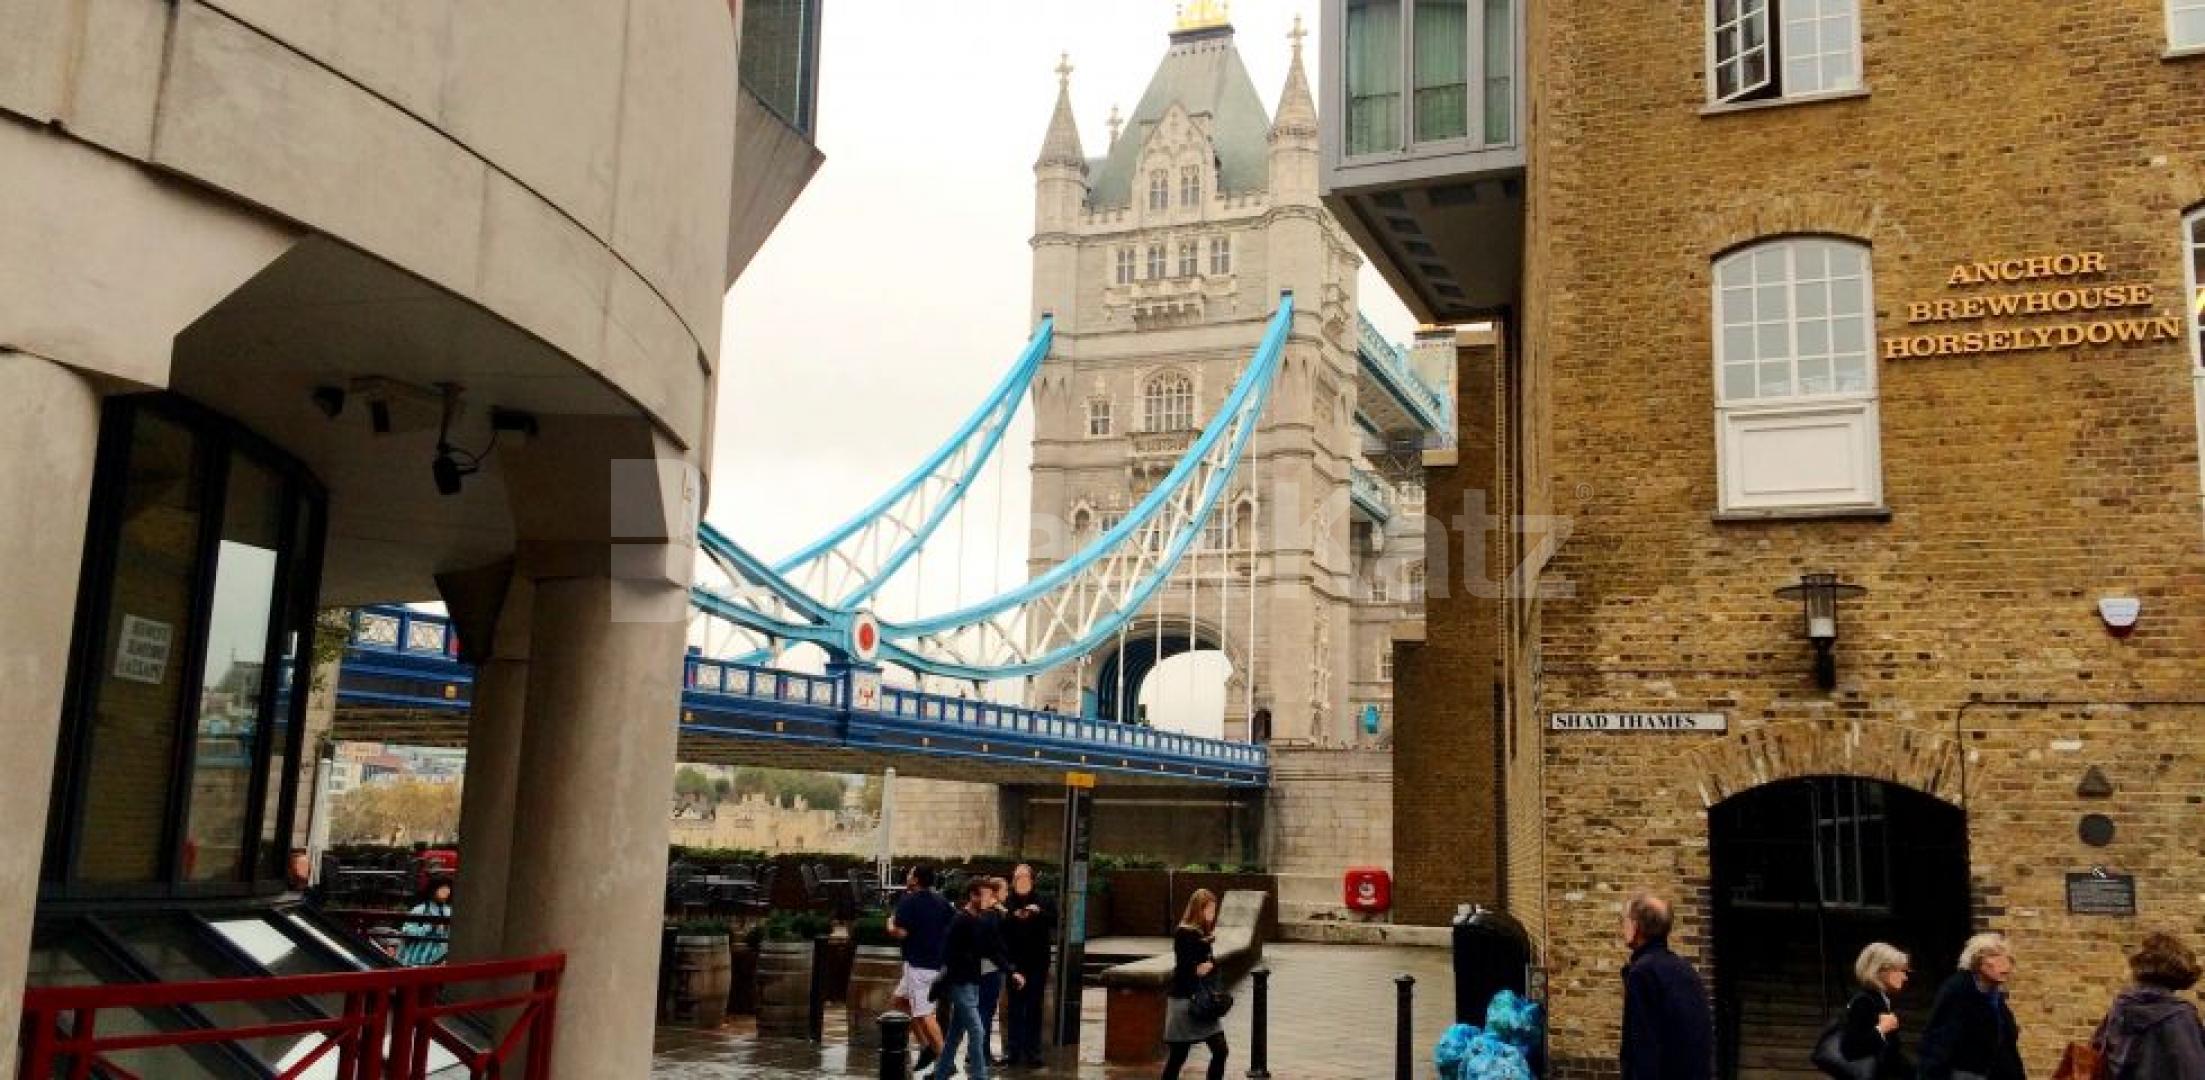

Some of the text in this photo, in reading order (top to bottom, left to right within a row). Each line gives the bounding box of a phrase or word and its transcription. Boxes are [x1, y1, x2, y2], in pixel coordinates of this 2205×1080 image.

[1947, 251, 2106, 286] ANCHOR
[1907, 284, 2153, 323] BREWHOUSE
[1882, 316, 2181, 359] HORSELYDOWN
[1556, 714, 1697, 728] SHAD THAMES
